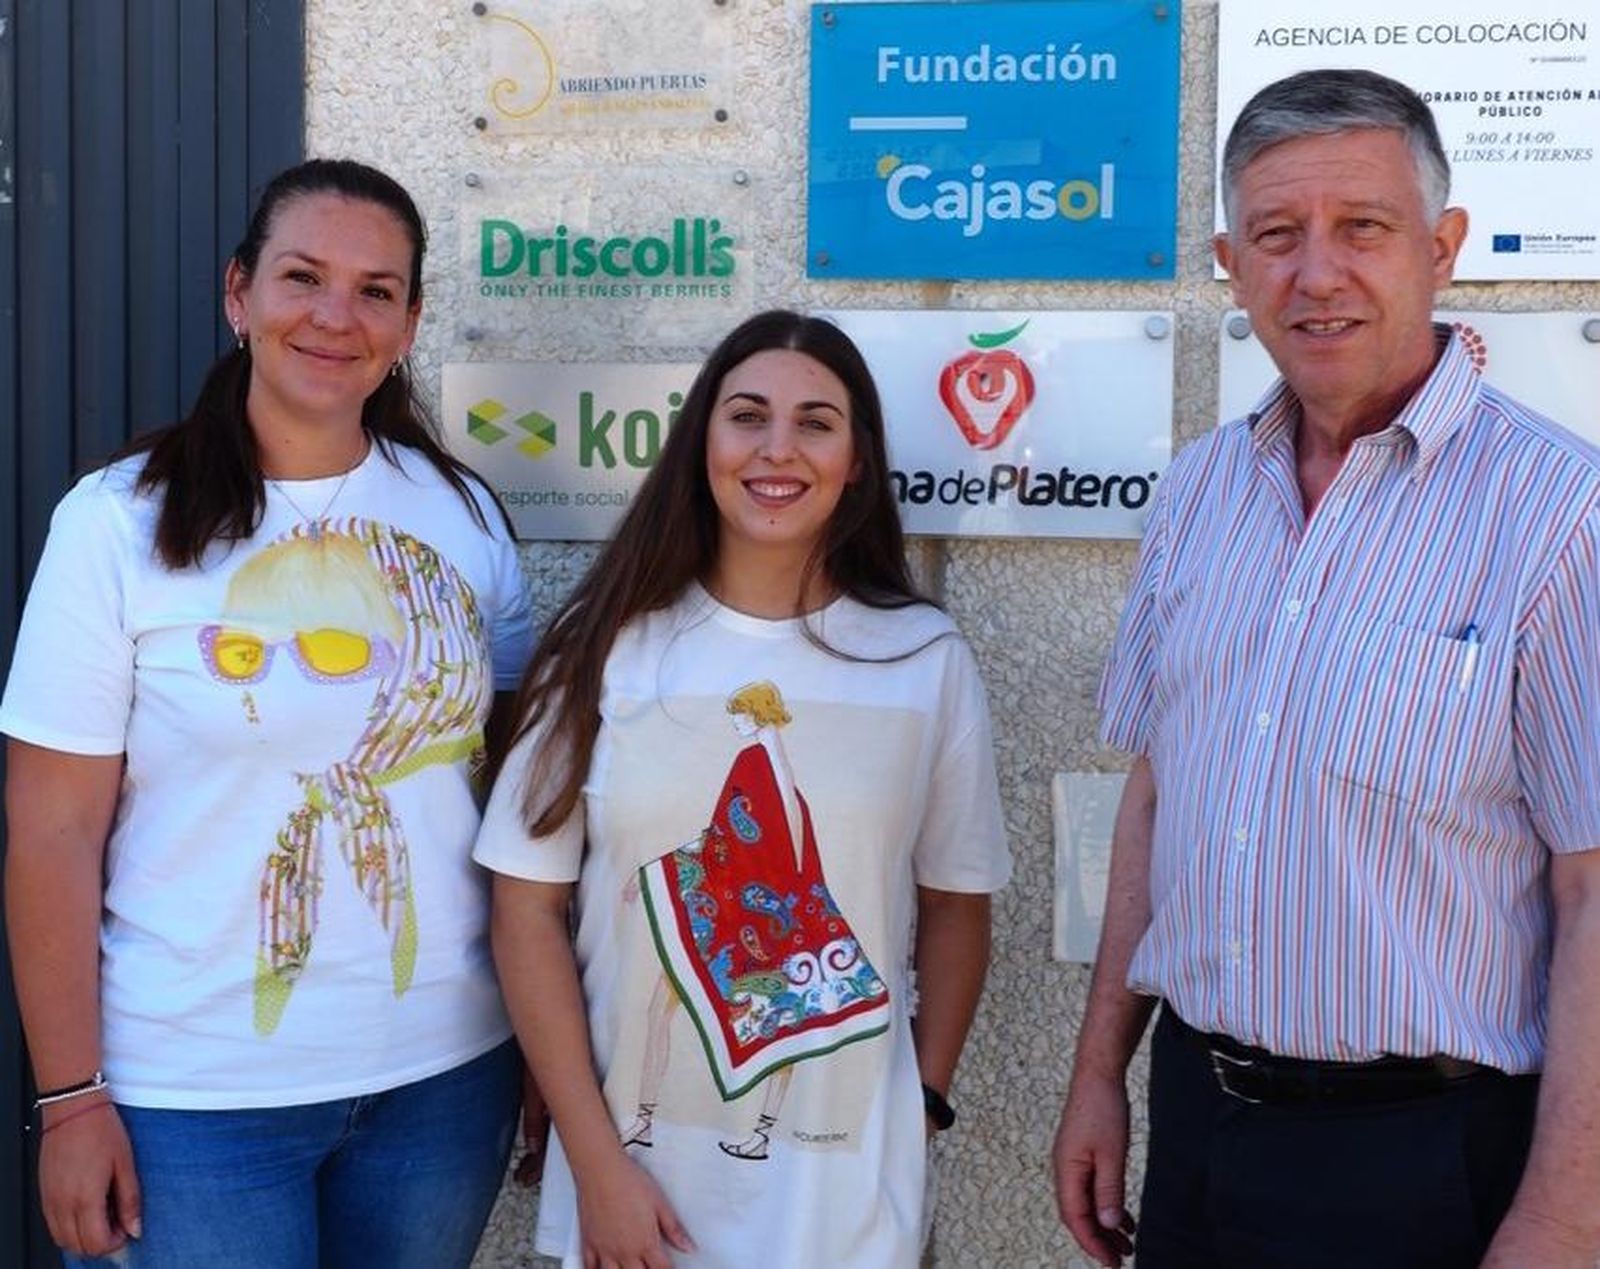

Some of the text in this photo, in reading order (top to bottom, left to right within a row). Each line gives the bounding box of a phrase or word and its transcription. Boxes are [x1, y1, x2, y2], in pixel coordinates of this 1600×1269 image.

[1255, 18, 1587, 46] AGENCIA DE COLOCACIÓN
[878, 43, 1117, 82] Fundación
[560, 74, 707, 93] ABRIENDO PUERTAS
[1484, 91, 1501, 101] DE
[1508, 88, 1582, 101] ATENCIÓN
[1479, 105, 1543, 117] PÚBLICO
[1465, 132, 1555, 145] 9:00 A 14:00
[1453, 149, 1594, 162] LUNES A VIERNES
[886, 163, 1114, 237] Cajasol
[480, 218, 736, 278] Driscoll's
[480, 283, 733, 299] ONLY THE FINEST BERRIES
[575, 489, 630, 506] social
